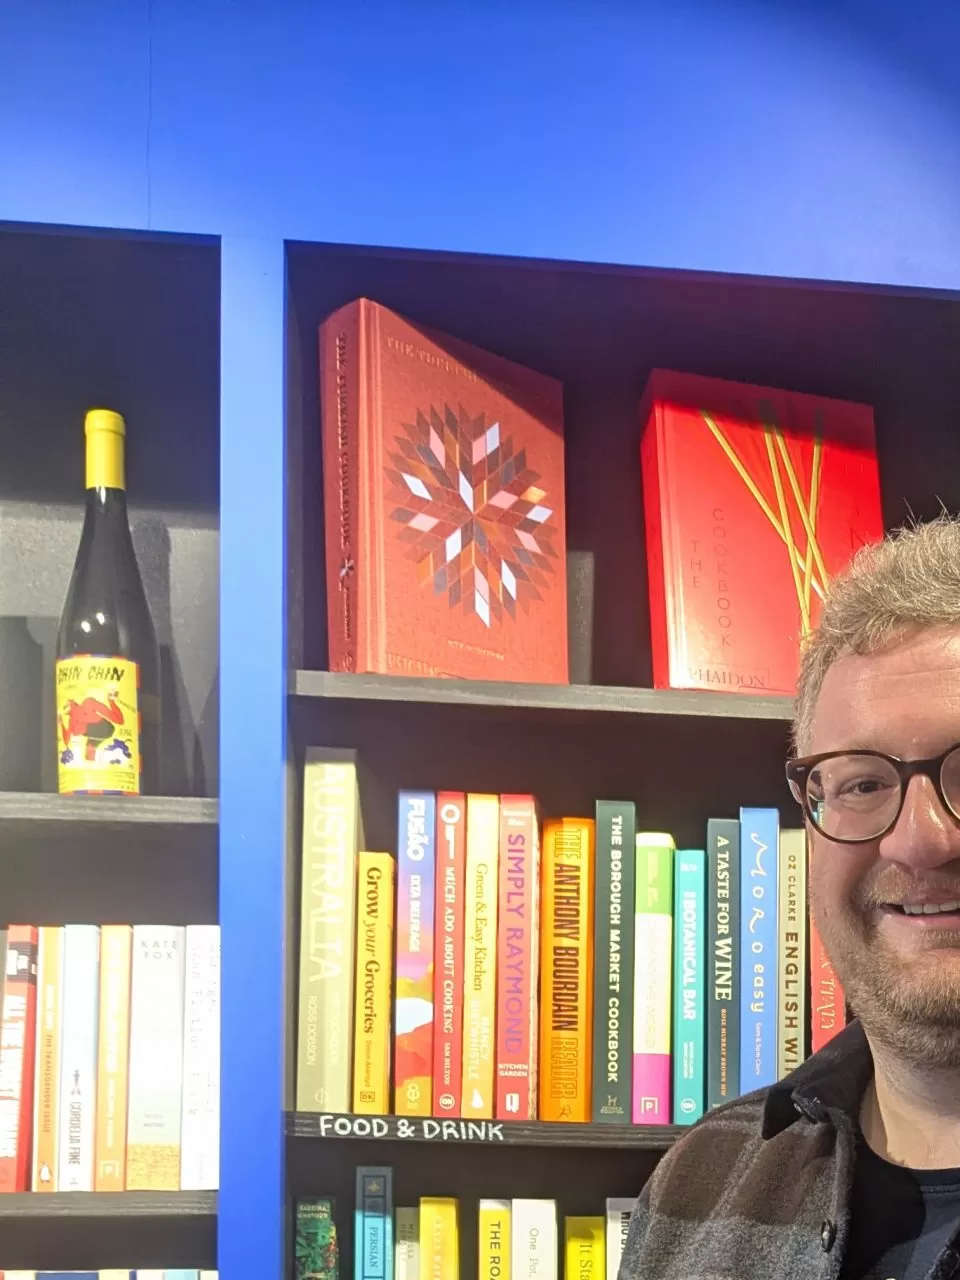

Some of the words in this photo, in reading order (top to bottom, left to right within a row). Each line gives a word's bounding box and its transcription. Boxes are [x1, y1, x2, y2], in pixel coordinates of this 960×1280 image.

[88, 666, 125, 681] CHIN
[687, 668, 765, 688] PHAIDON
[553, 828, 581, 859] THE
[611, 816, 622, 845] THE
[717, 836, 729, 847] A
[507, 834, 525, 918] SIMPLY
[716, 852, 729, 899] TASTE
[789, 855, 796, 870] OZ
[367, 867, 381, 918] Grow
[553, 863, 581, 941] ANTHONY
[610, 850, 622, 925] BOROUGH
[788, 876, 796, 922] CLARKE
[363, 920, 376, 957] your
[716, 905, 729, 935] FOR
[609, 930, 621, 992] MARKET
[715, 938, 731, 1001] WINE
[785, 932, 798, 1029] ENGLISH
[362, 960, 381, 1034] Groceries
[505, 927, 524, 1053] RAYMOND
[552, 946, 579, 1032] BOURDAIN
[608, 998, 619, 1082] COOKBOOK
[551, 1038, 577, 1099] READER
[319, 1117, 388, 1137] FOOD
[398, 1120, 413, 1136] &
[424, 1123, 503, 1140] DRINK
[490, 1221, 501, 1249] THE
